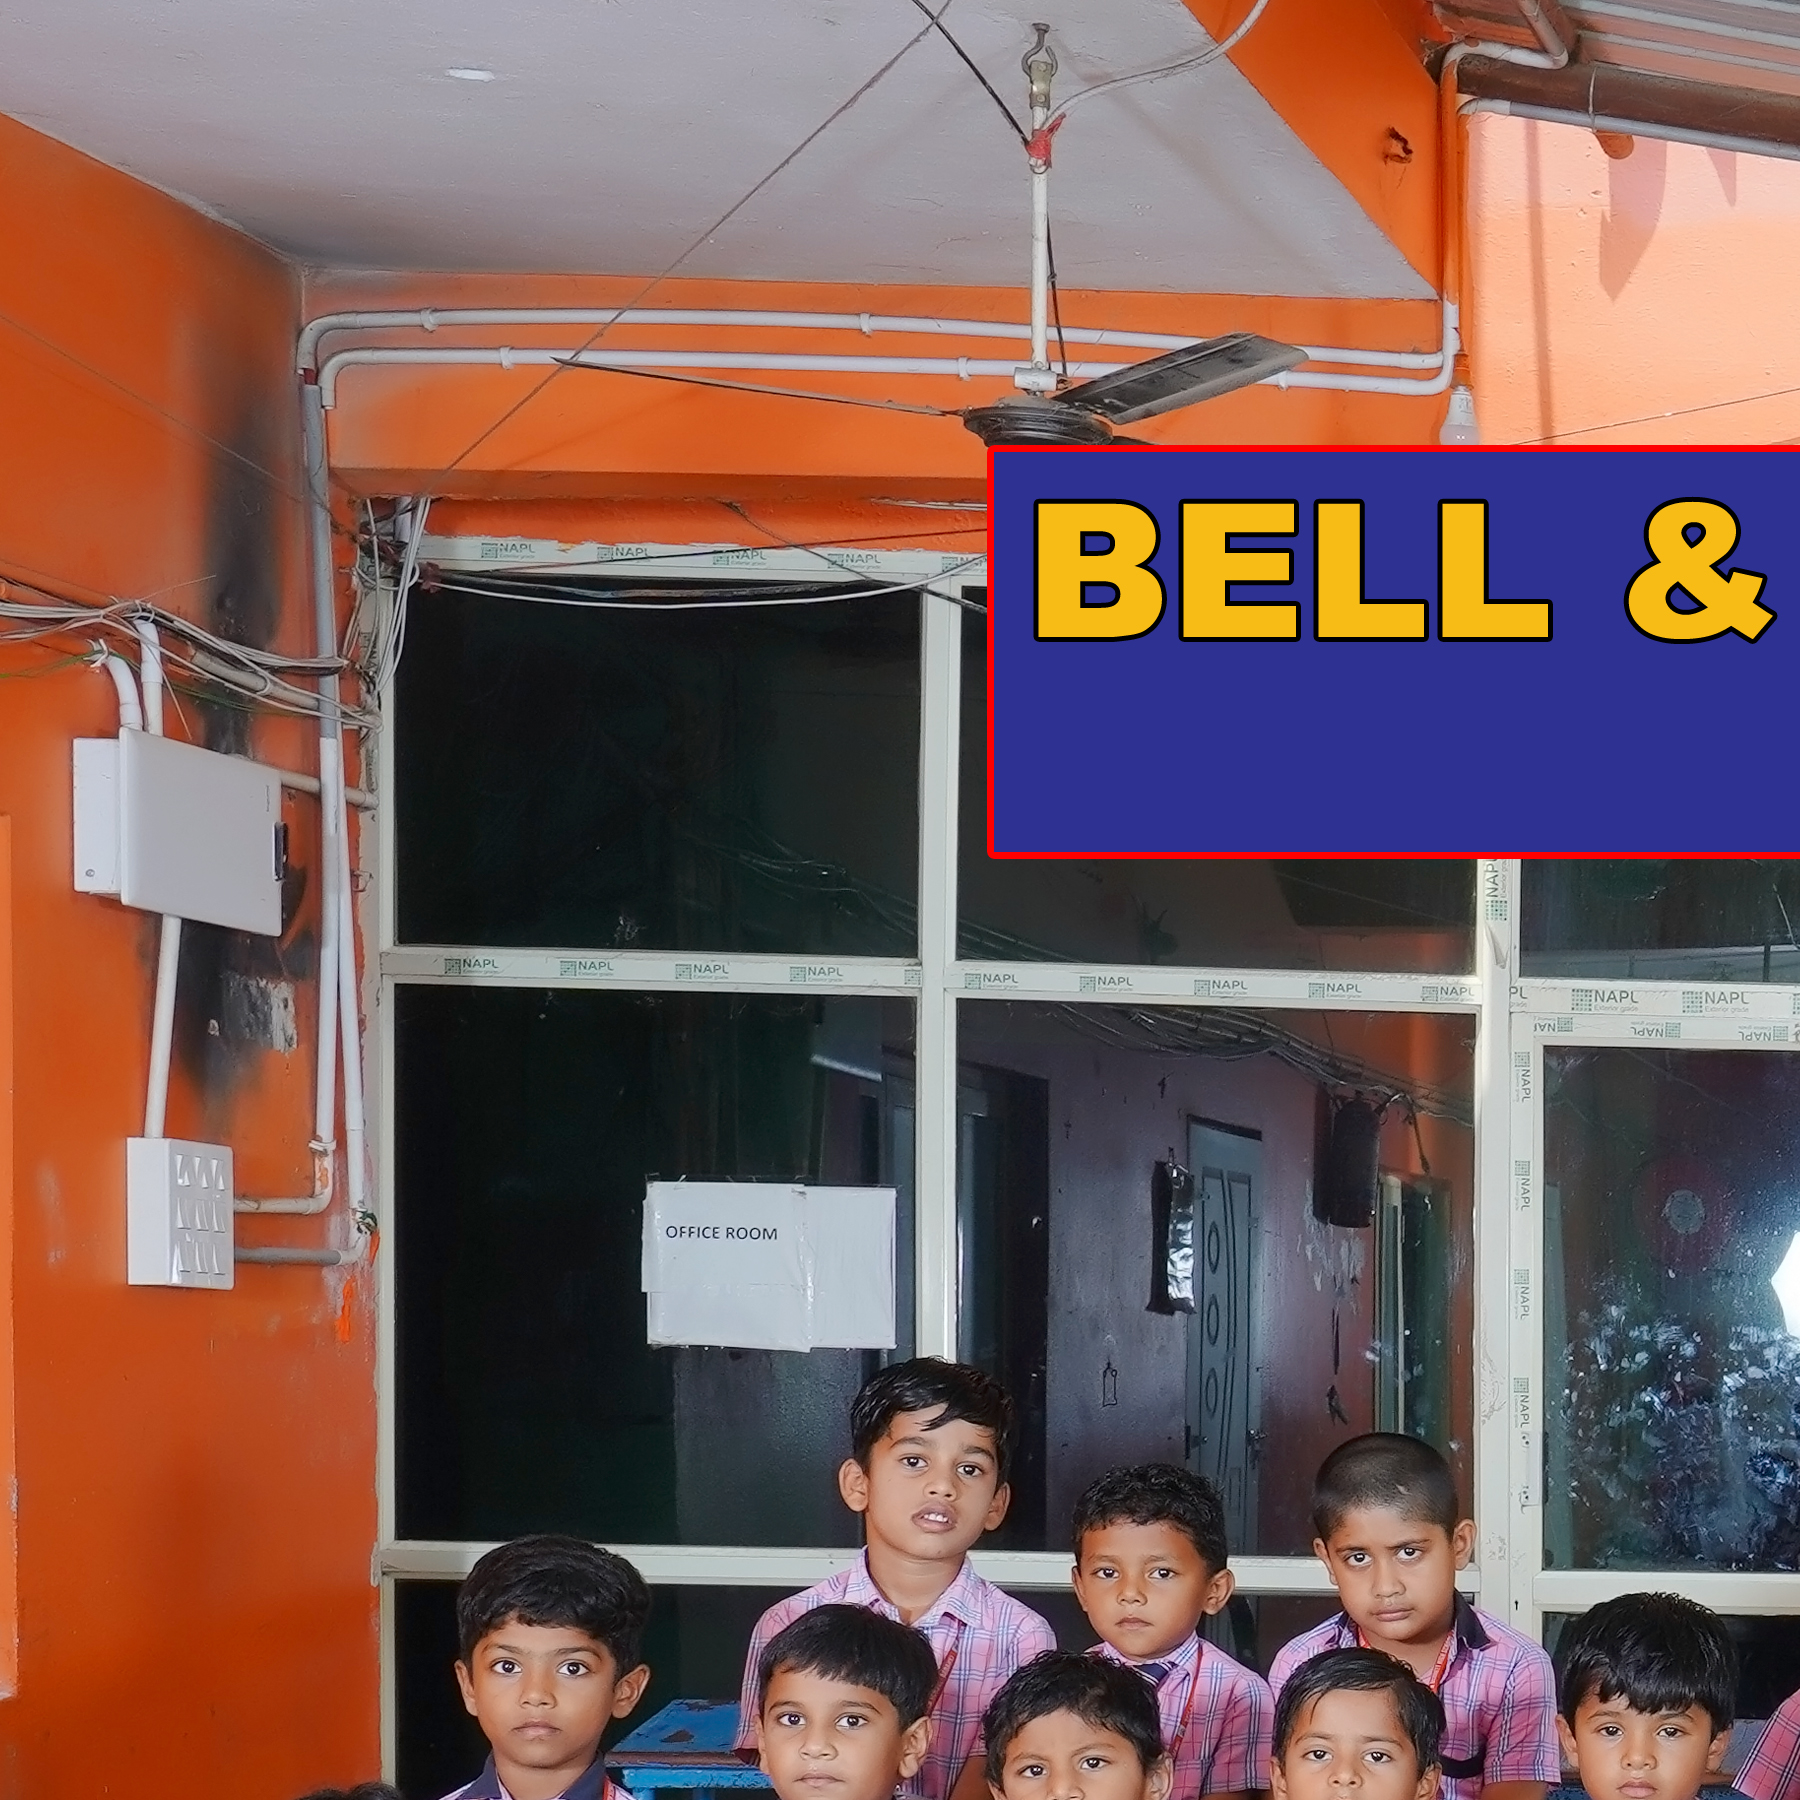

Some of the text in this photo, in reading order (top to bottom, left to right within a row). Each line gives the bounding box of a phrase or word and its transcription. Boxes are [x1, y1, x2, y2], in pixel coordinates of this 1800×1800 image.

[500, 543, 536, 554] NAPL
[845, 554, 881, 564] NAPL
[462, 958, 498, 969] NAPL
[578, 960, 614, 972] NAPL
[693, 964, 729, 975] NAPL
[808, 966, 844, 977] NAPL
[983, 974, 1019, 984] NAPL
[1097, 976, 1133, 987] NAPL
[1212, 980, 1248, 990] NAPL
[1326, 983, 1362, 993] NAPL
[1440, 986, 1475, 997] NAPL
[1594, 990, 1638, 1003] NAPL
[1705, 992, 1749, 1004] NAPL
[1631, 1026, 1664, 1037] NAPL
[1738, 1031, 1772, 1041] NAPL
[1521, 1069, 1531, 1103] NAPL
[1521, 1178, 1531, 1212] NAPL
[665, 1225, 778, 1240] OFFICE ROOM
[1520, 1286, 1530, 1320] NAPL
[1520, 1394, 1530, 1428] NAPL
